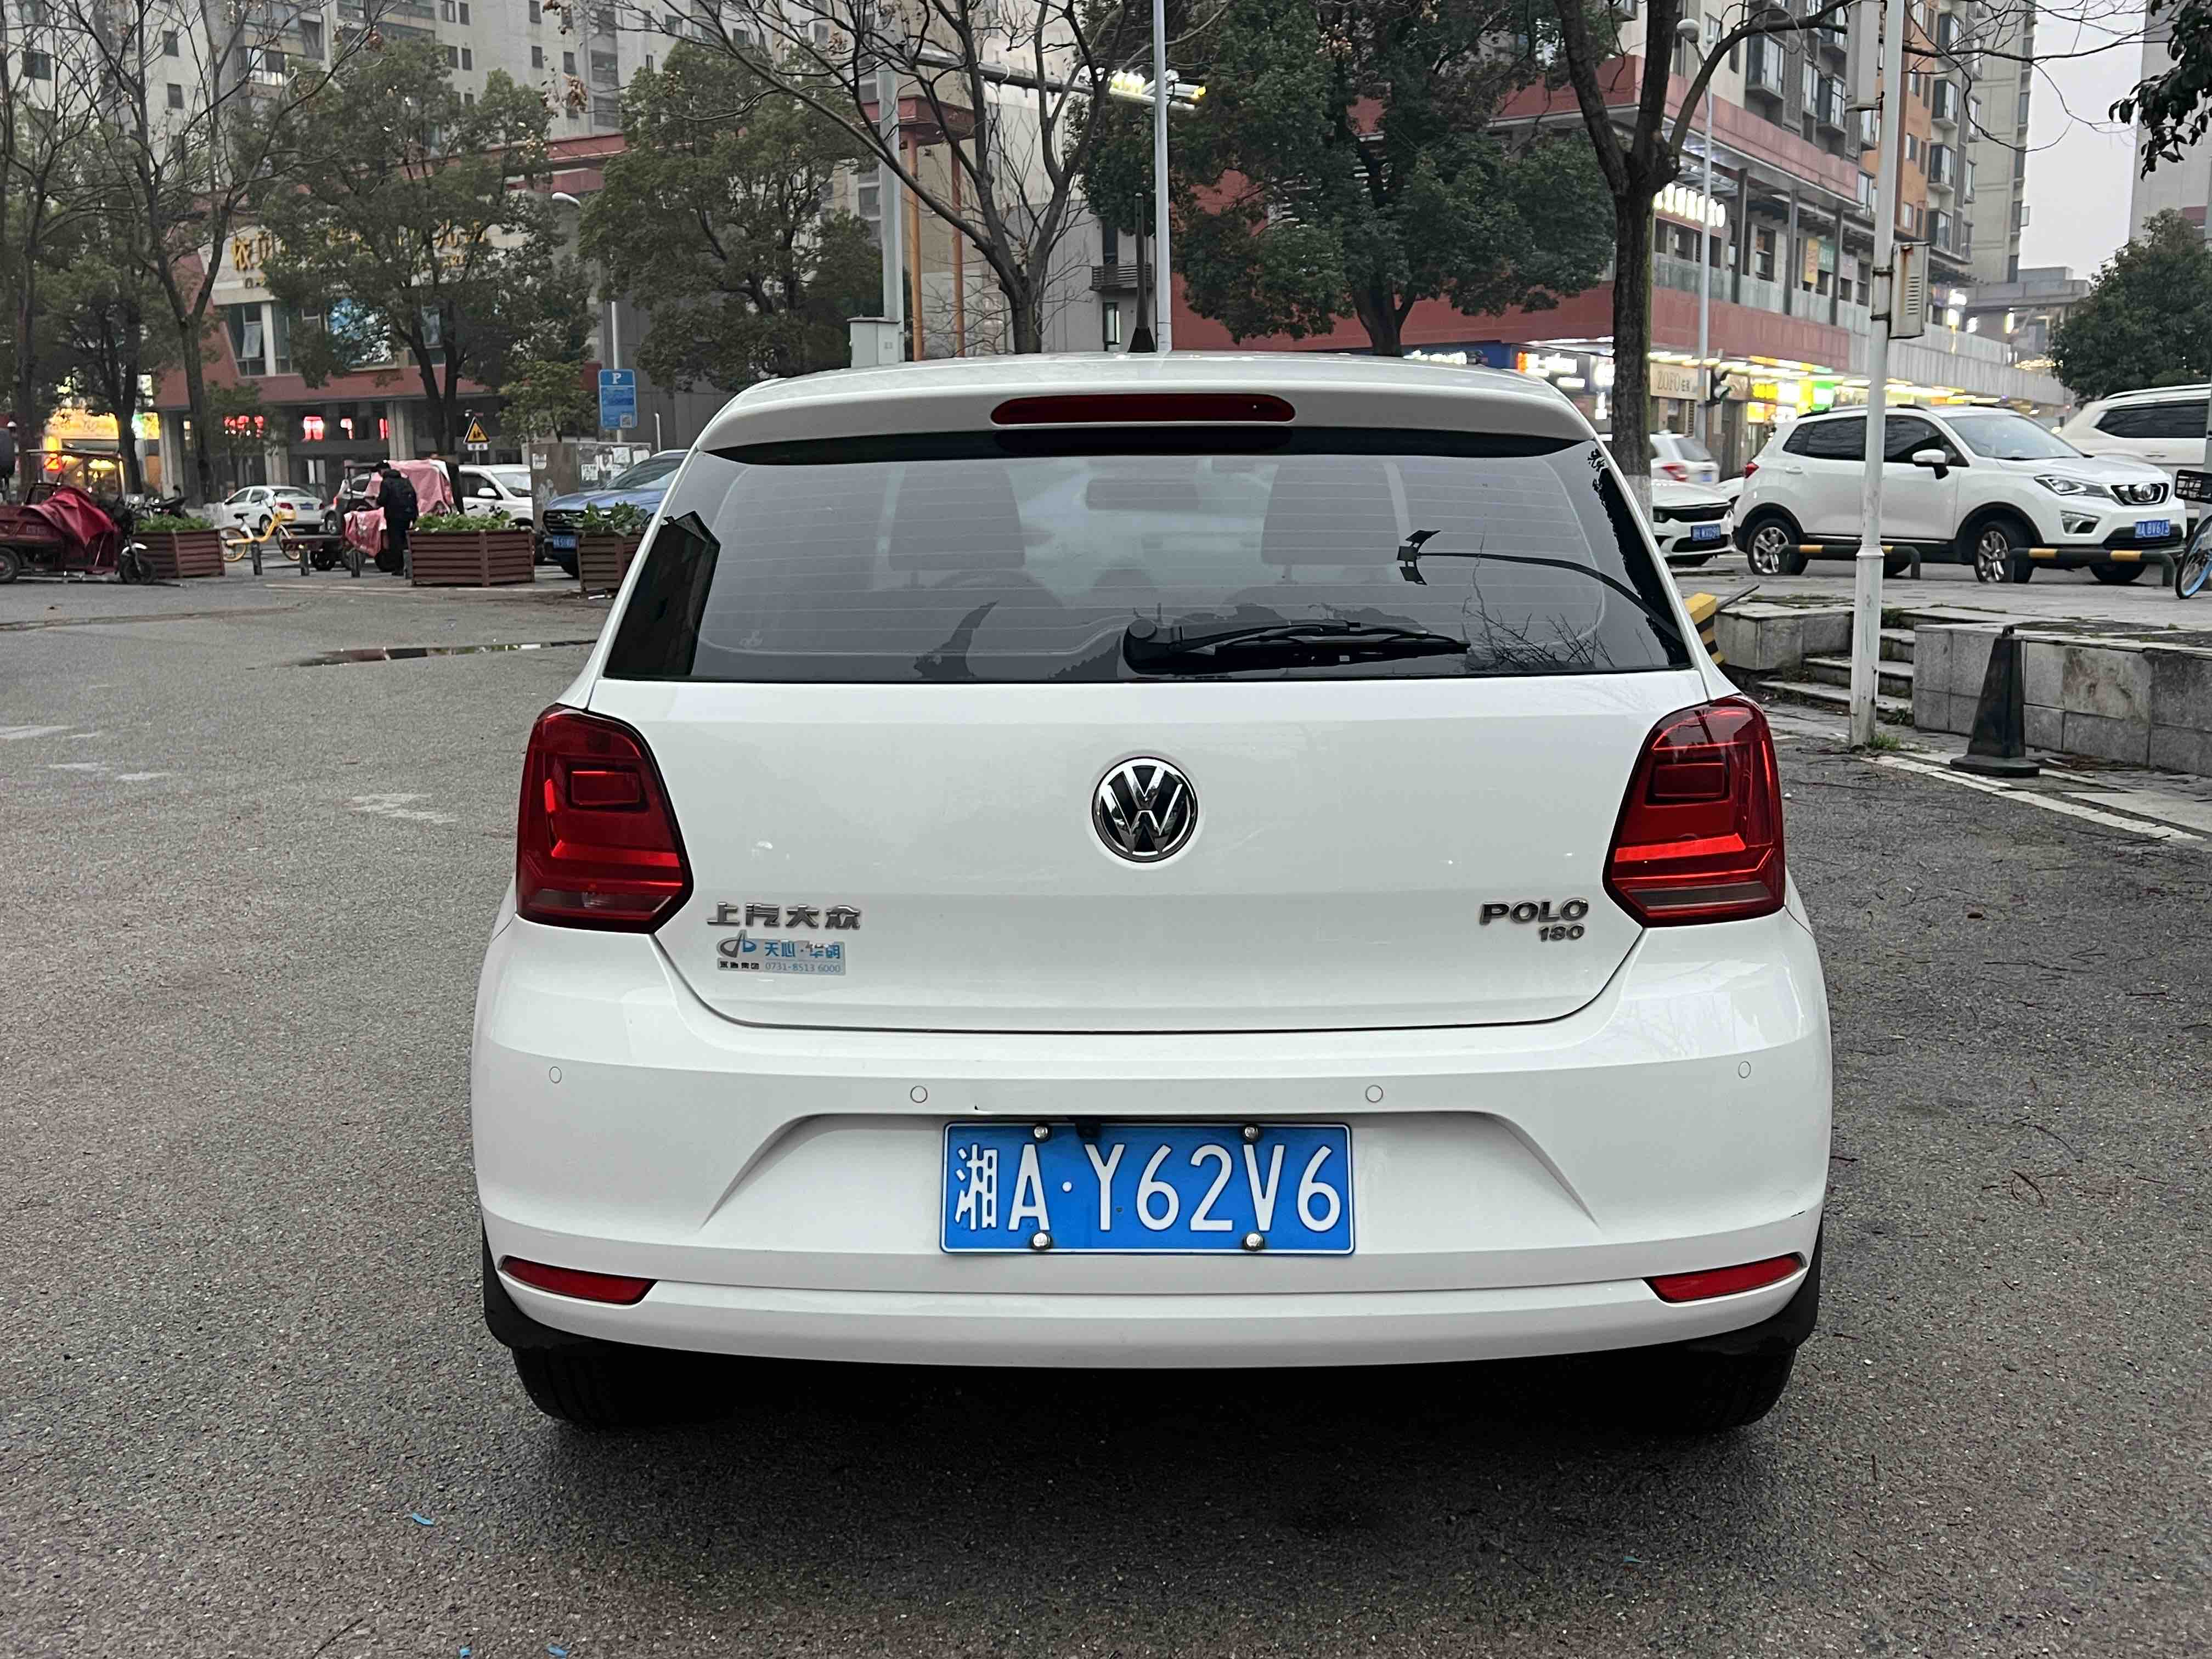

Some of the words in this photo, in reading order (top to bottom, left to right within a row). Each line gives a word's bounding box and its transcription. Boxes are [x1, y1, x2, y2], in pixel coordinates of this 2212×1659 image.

[612, 372, 622, 385] P
[706, 901, 861, 930] 上汽大众
[1479, 898, 1589, 926] POLO
[1539, 922, 1585, 942] 180
[955, 1143, 1341, 1233] 湘A·Y62V6
